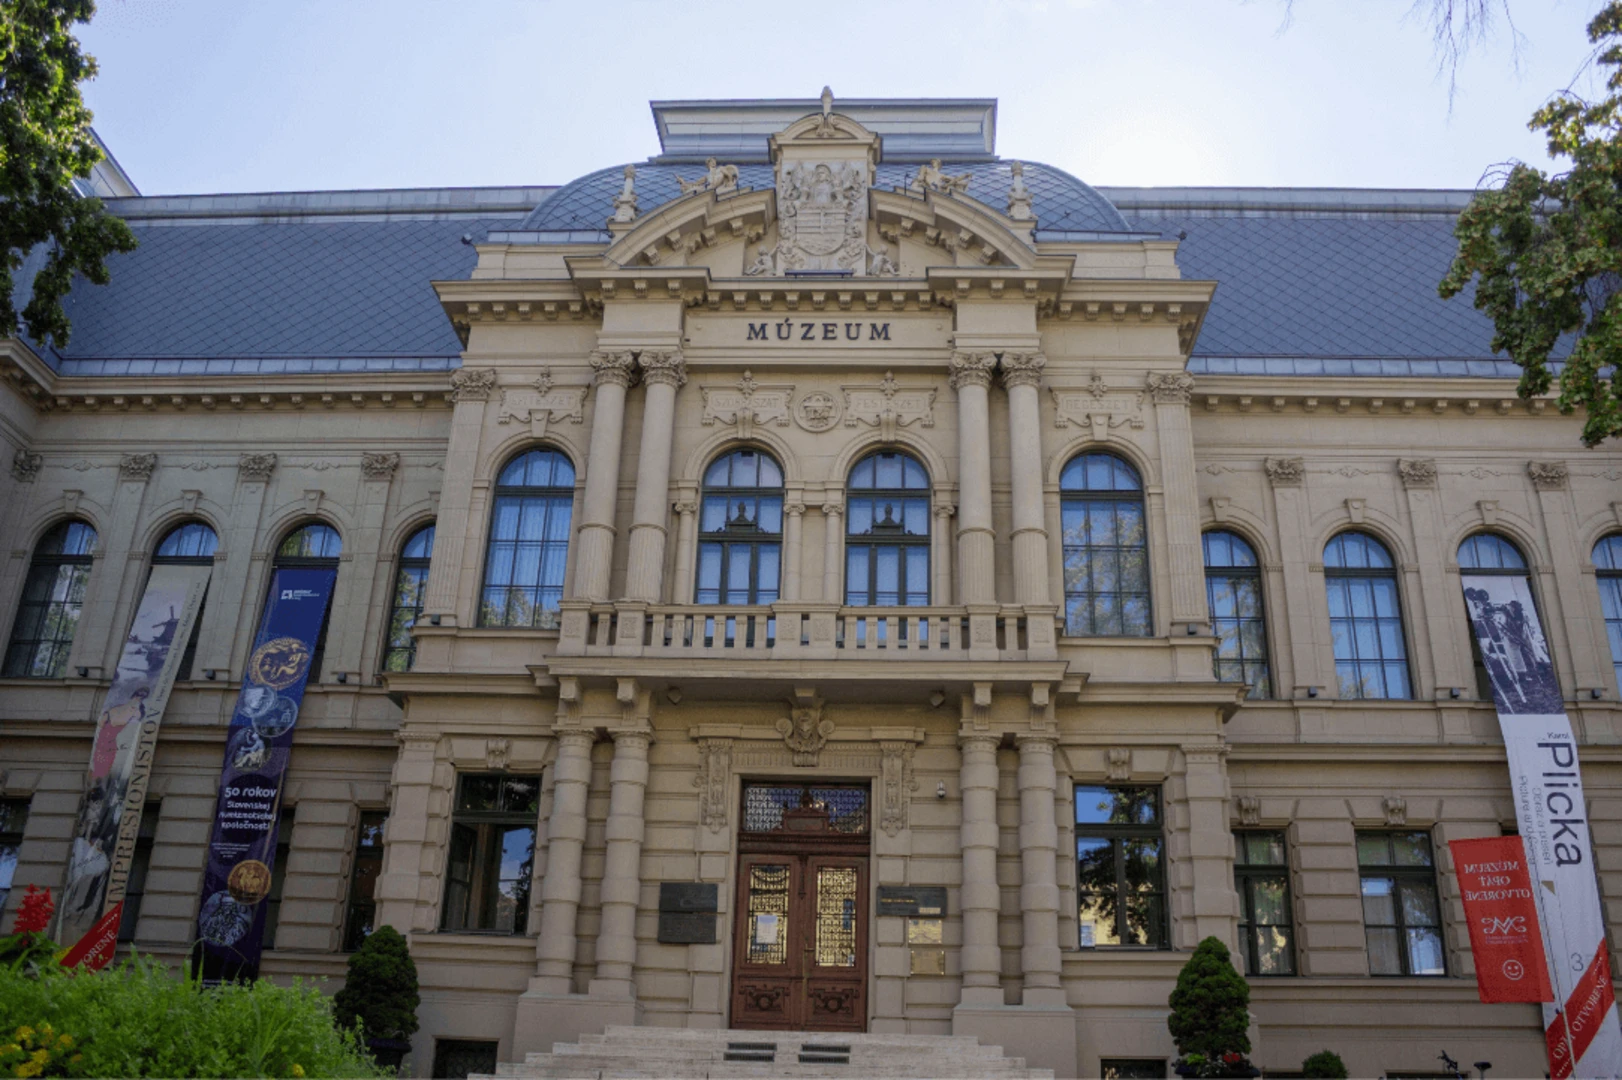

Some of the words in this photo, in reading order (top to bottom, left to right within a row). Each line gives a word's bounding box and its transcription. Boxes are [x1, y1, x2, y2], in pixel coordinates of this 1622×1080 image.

[746, 317, 891, 341] MÚZEUM
[224, 787, 240, 798] 50
[242, 786, 277, 798] rokov
[108, 707, 160, 904] IMPRESIONISTOV
[227, 801, 270, 811] Slovenskej
[1537, 742, 1585, 867] Plicka
[221, 820, 271, 830] spoločnosti
[80, 929, 117, 964] ORENÉ
